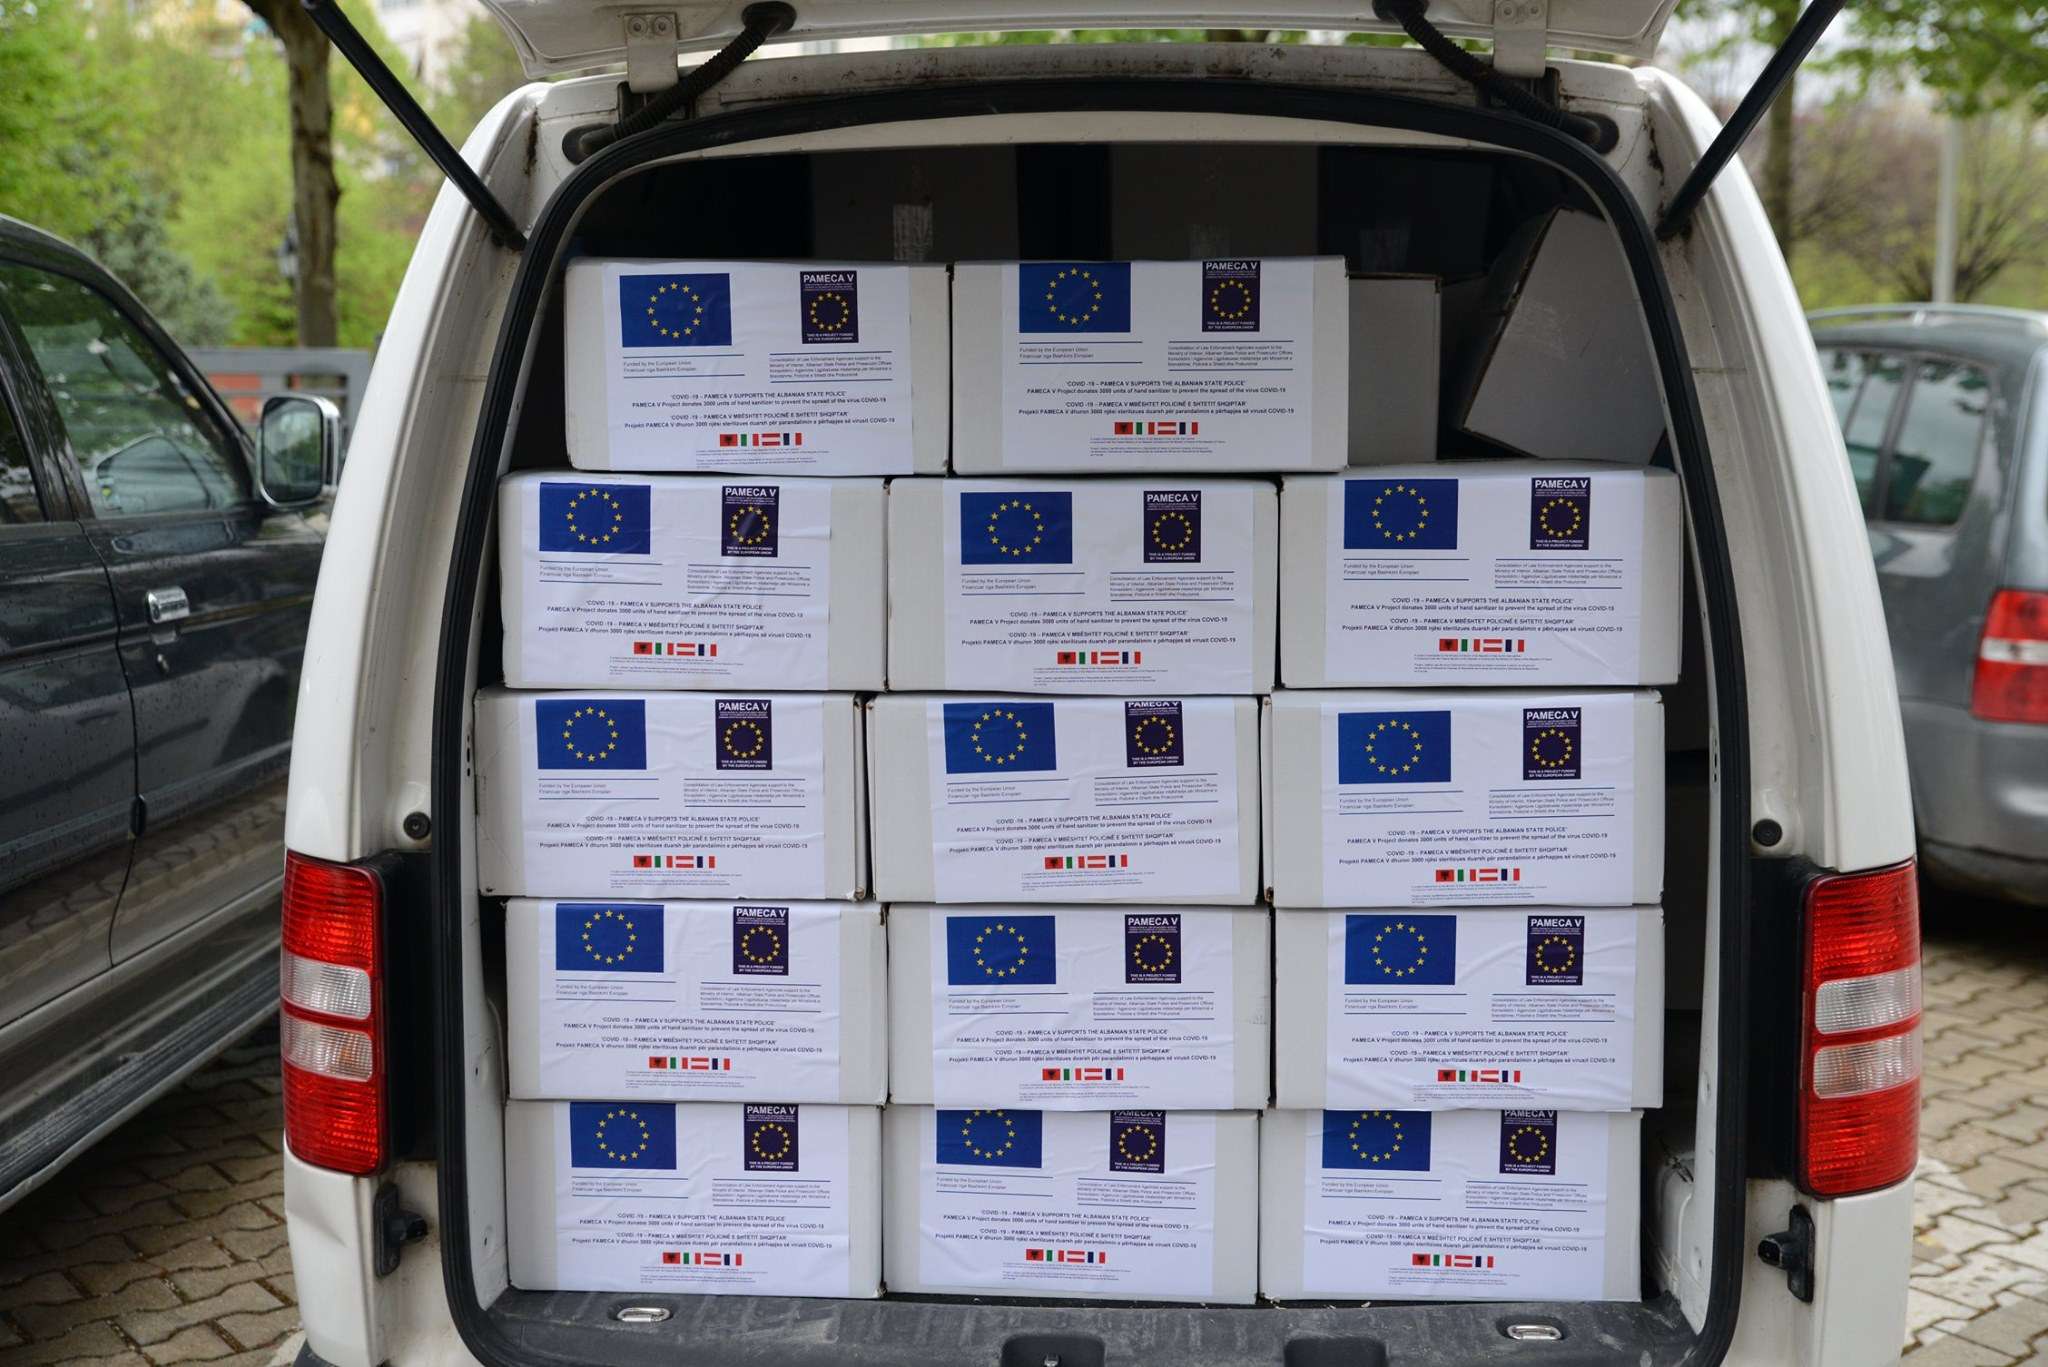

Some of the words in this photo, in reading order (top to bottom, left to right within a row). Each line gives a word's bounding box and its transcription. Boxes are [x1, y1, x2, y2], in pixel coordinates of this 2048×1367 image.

[1206, 262, 1248, 272] PAMECA
[1249, 262, 1258, 271] V
[803, 273, 845, 283] PAMECA
[846, 273, 855, 283] V
[1535, 480, 1578, 489] PAMECA
[1580, 480, 1588, 489] V
[725, 488, 767, 497] PAMECA
[768, 488, 777, 498] V
[1147, 493, 1189, 503] PAMECA
[1190, 493, 1199, 502] V
[718, 702, 760, 711] PAMECA
[761, 702, 770, 711] V
[1526, 710, 1569, 720] PAMECA
[1570, 710, 1579, 719] V
[736, 908, 777, 918] PAMECA
[778, 909, 787, 918] V
[1128, 917, 1169, 926] PAMECA
[1170, 917, 1179, 926] V
[1531, 918, 1573, 927] PAMECA
[1574, 918, 1583, 927] V
[746, 1105, 787, 1115] PAMECA
[788, 1106, 797, 1115] V
[1504, 1110, 1545, 1118] PAMECA
[1547, 1110, 1554, 1118] V
